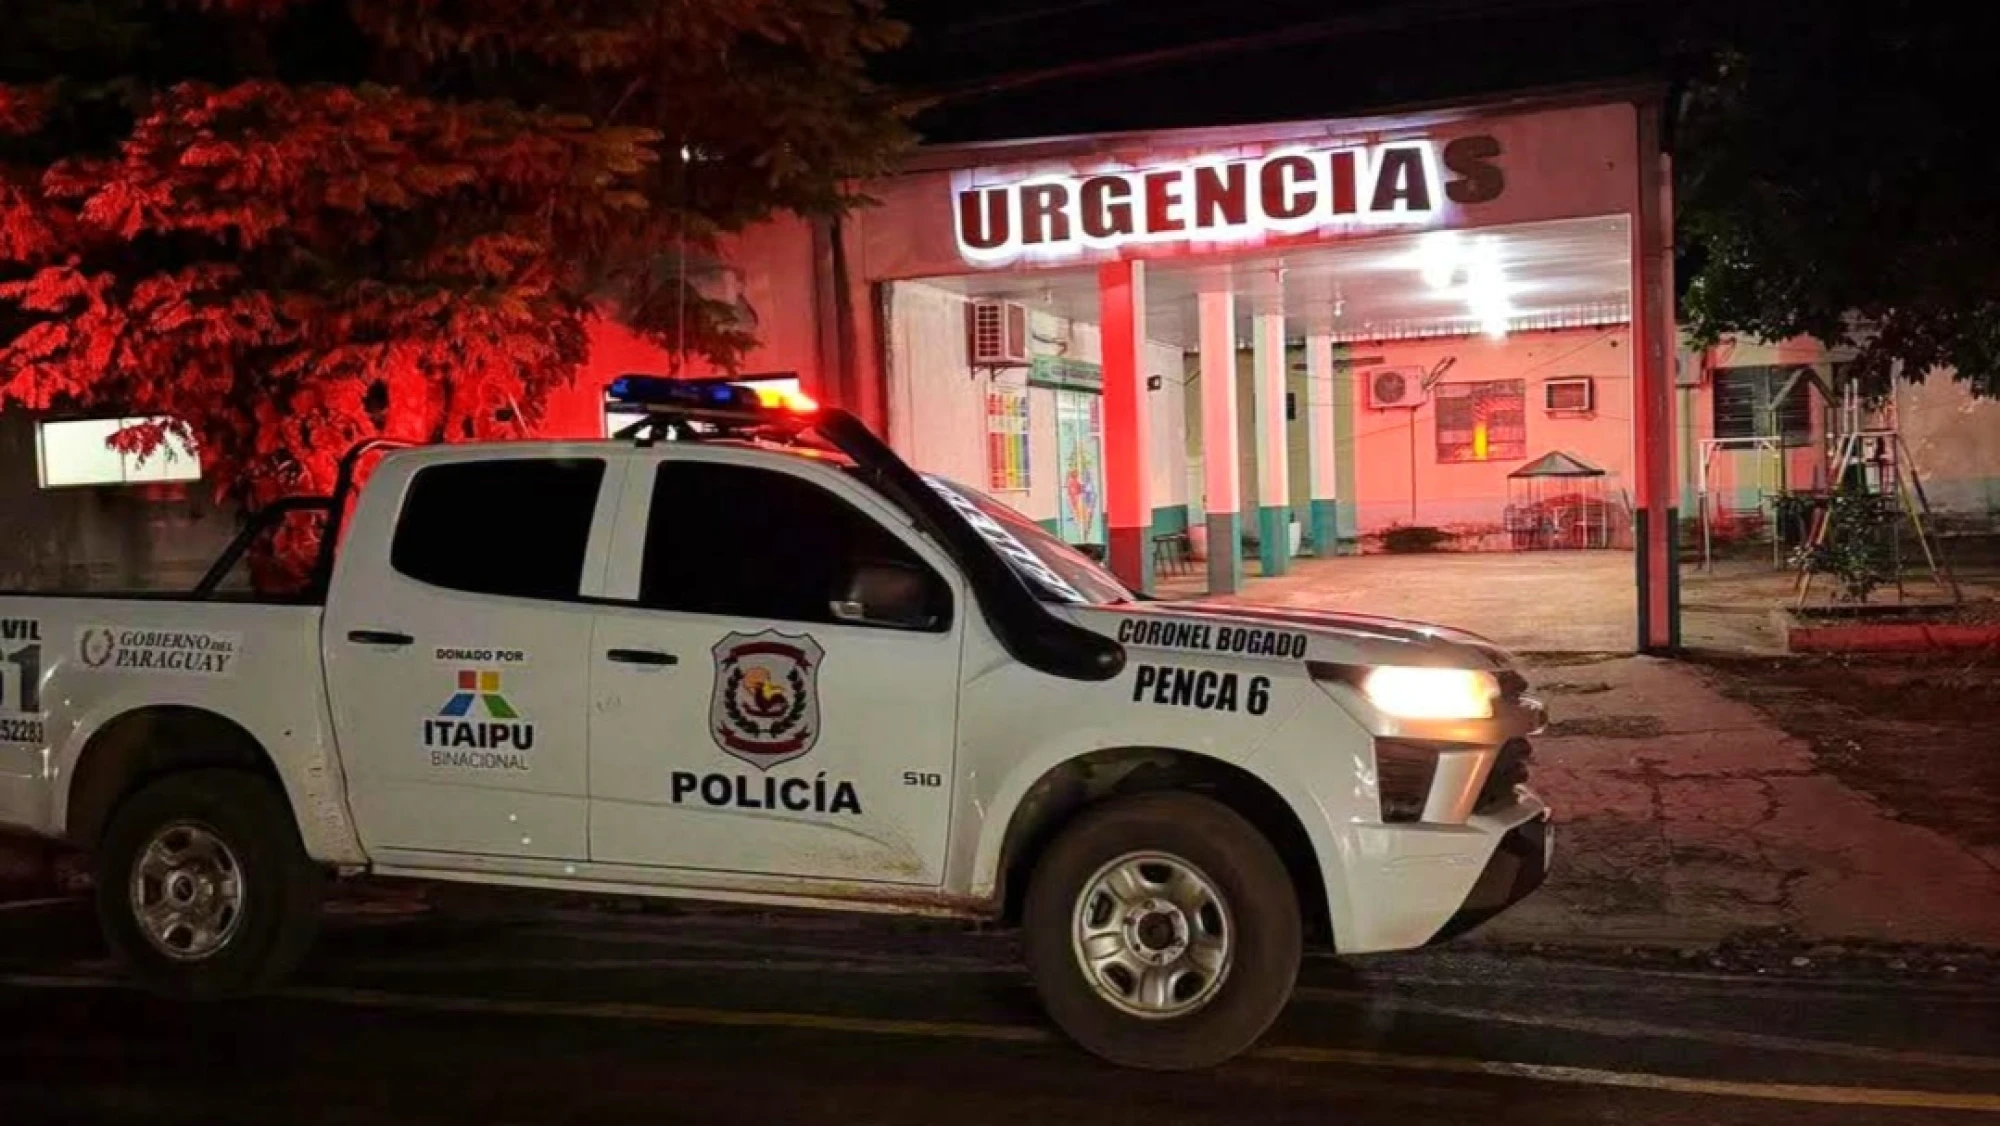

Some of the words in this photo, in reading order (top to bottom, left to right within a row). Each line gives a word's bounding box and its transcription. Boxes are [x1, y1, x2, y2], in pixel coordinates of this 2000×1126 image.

[959, 134, 1505, 251] URGENCIAS
[120, 630, 210, 650] GOBIERNO
[1118, 618, 1211, 650] CORONEL
[1216, 626, 1307, 659] BOGADO
[115, 648, 231, 673] PARAGUAY
[436, 648, 492, 660] DONADO
[496, 650, 524, 661] POR
[1132, 664, 1238, 712] PENCA
[1246, 675, 1271, 716] 6
[424, 719, 533, 750] ITAIPU
[431, 750, 529, 770] BINACIONAL
[671, 771, 863, 815] POLICÍA
[903, 771, 942, 788] S10
